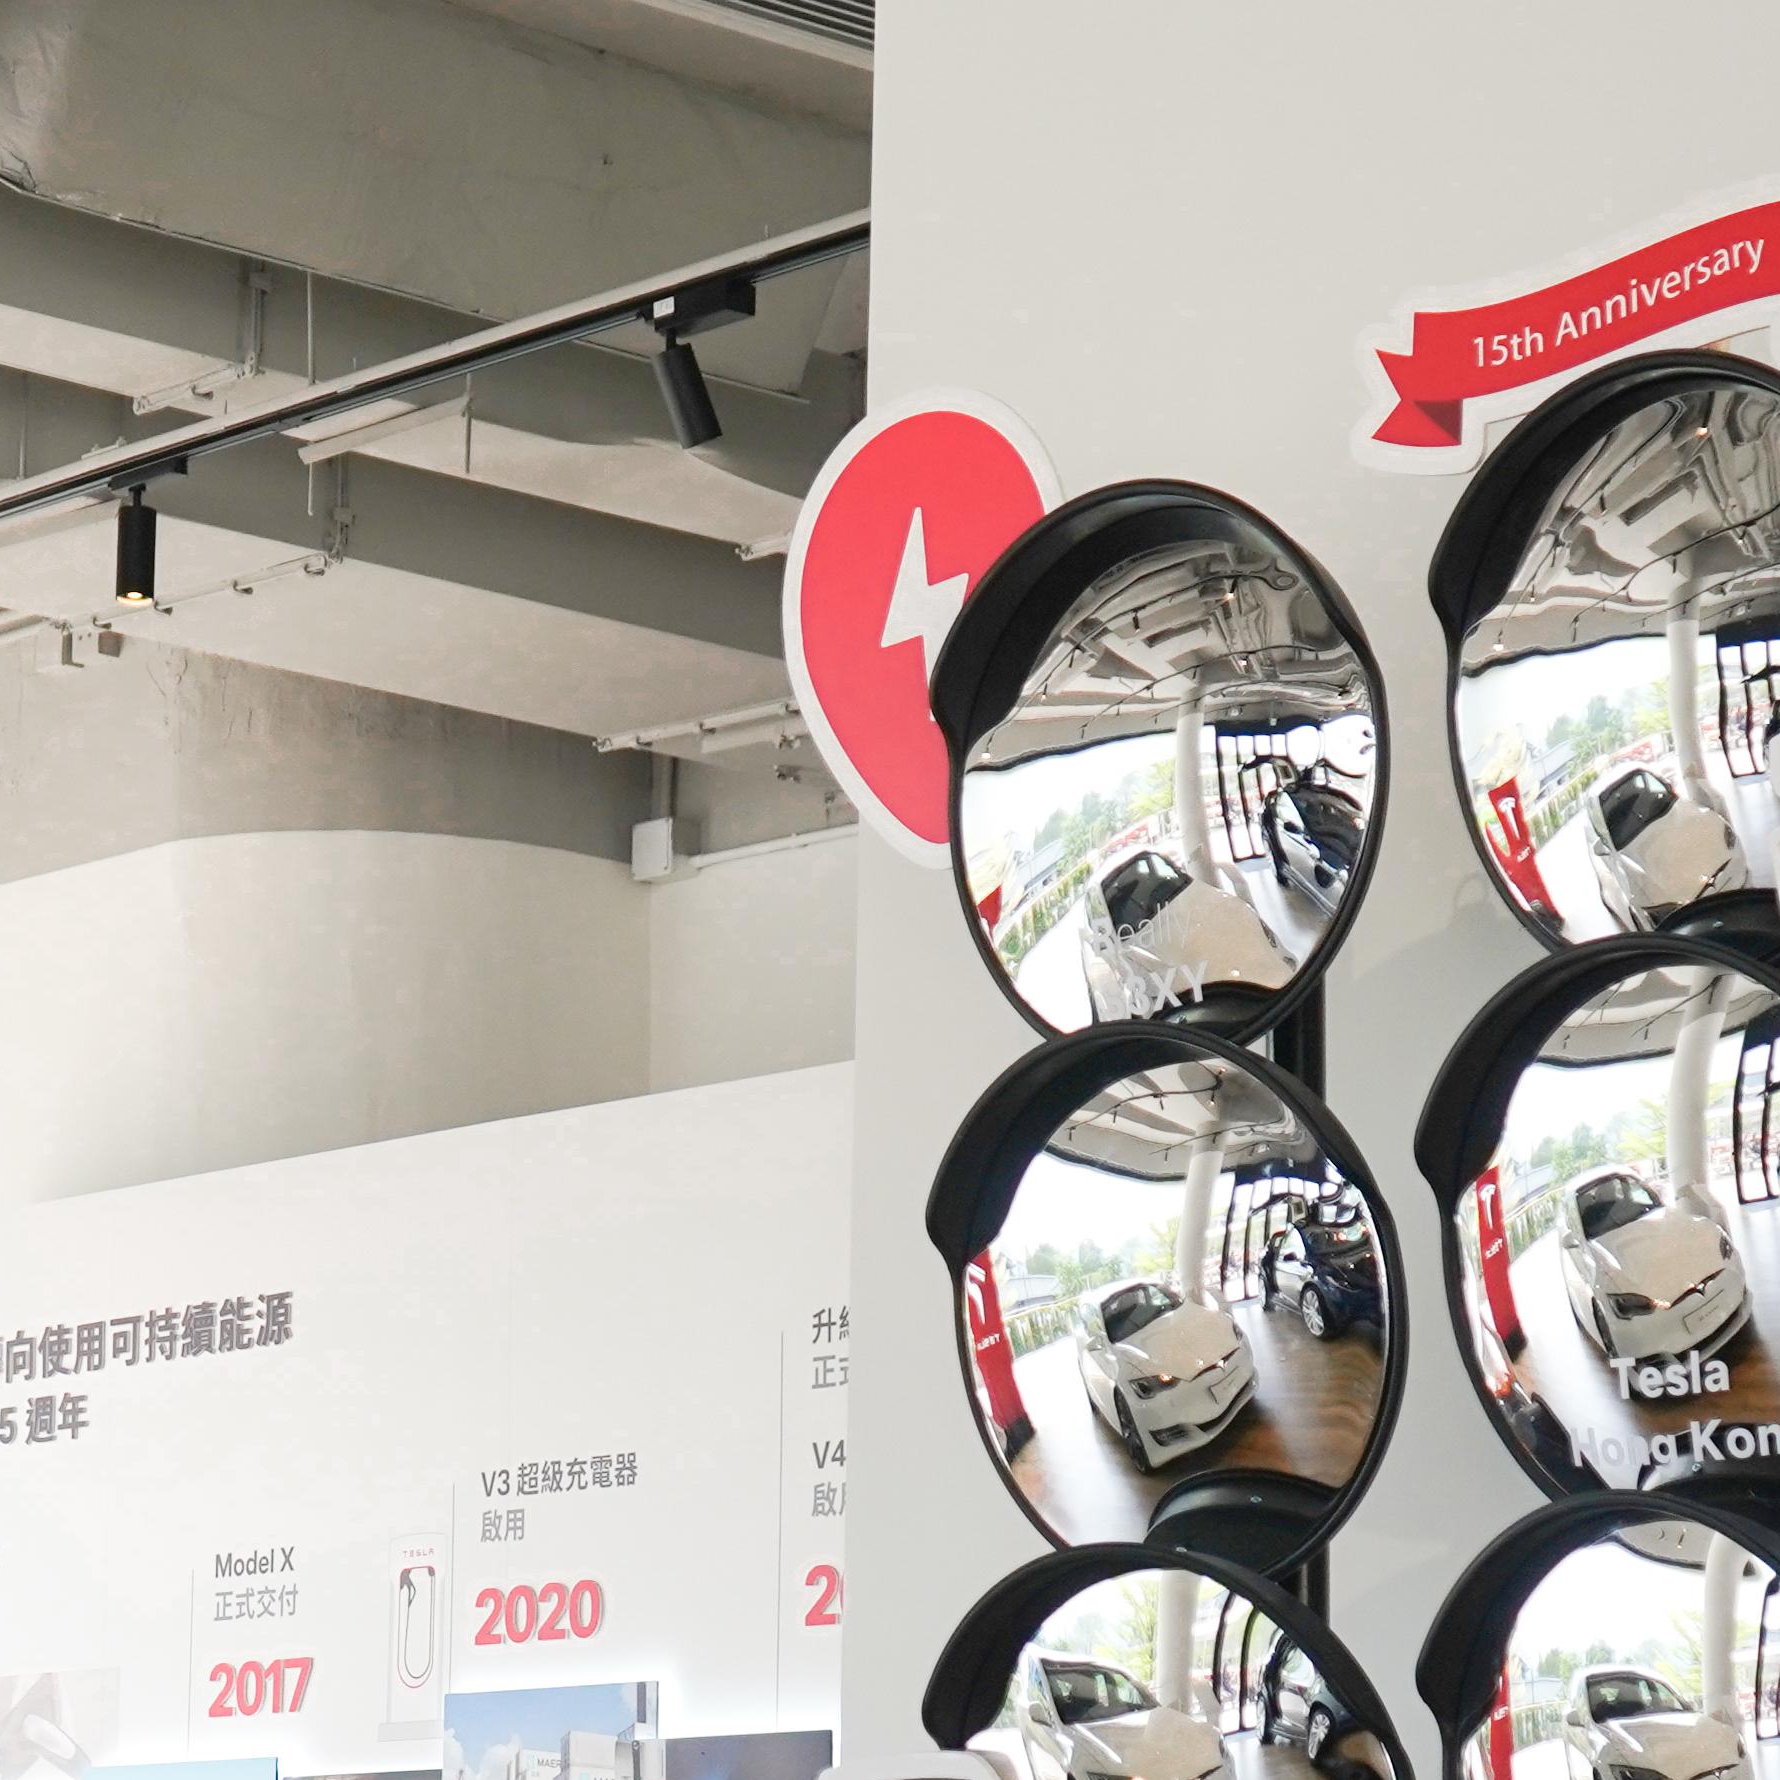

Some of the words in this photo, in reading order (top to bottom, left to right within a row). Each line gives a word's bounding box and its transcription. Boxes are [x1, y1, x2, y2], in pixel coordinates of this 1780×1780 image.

[1473, 327, 1545, 368] 15th
[1554, 238, 1765, 346] Anniversary
[1611, 1349, 1730, 1400] Tesla
[24, 1391, 91, 1445] 週年
[480, 1468, 511, 1498] V3
[516, 1451, 638, 1496] 超級充電器
[480, 1508, 526, 1543] 啟用
[214, 1548, 275, 1579] Model
[278, 1545, 295, 1573] X
[213, 1582, 299, 1622] 正式交付
[474, 1579, 604, 1646] 2020
[207, 1656, 315, 1718] 2017
